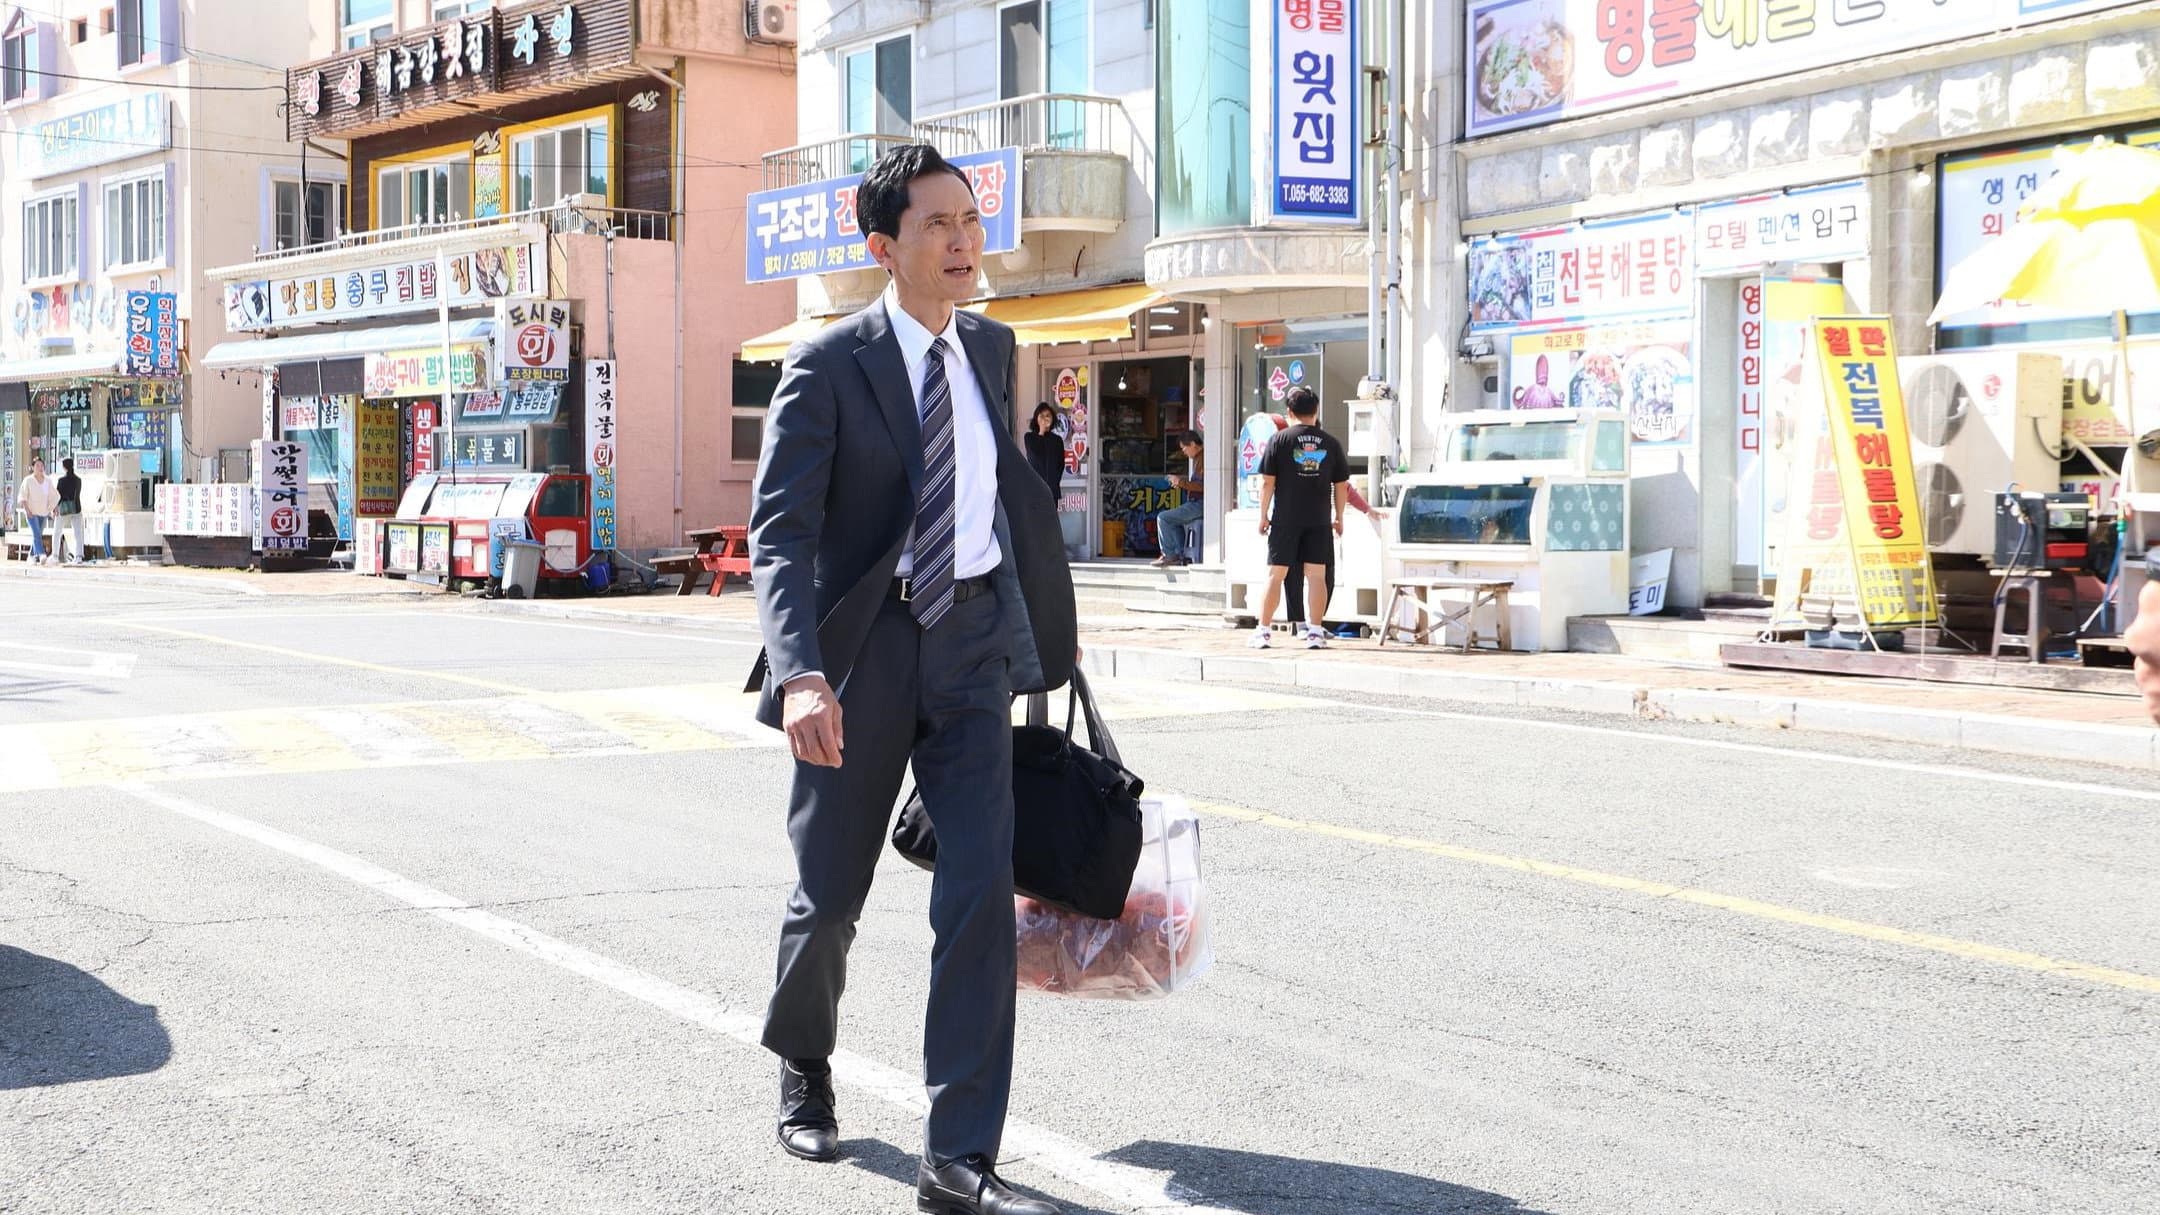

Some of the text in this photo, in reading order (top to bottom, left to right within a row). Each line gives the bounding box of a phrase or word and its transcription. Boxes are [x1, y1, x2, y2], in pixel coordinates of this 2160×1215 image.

[1283, 184, 1348, 204] T.055-682-3383
[756, 193, 829, 249] 구조라
[1705, 219, 1747, 250] 모텔
[1812, 204, 1859, 238] 입구
[1560, 234, 1688, 304] 전복해물탕
[509, 303, 566, 328] 도시락
[510, 368, 564, 380] 포장됩니다
[1842, 362, 1904, 540] 전복해물탕
[200, 486, 208, 531] 생선구이
